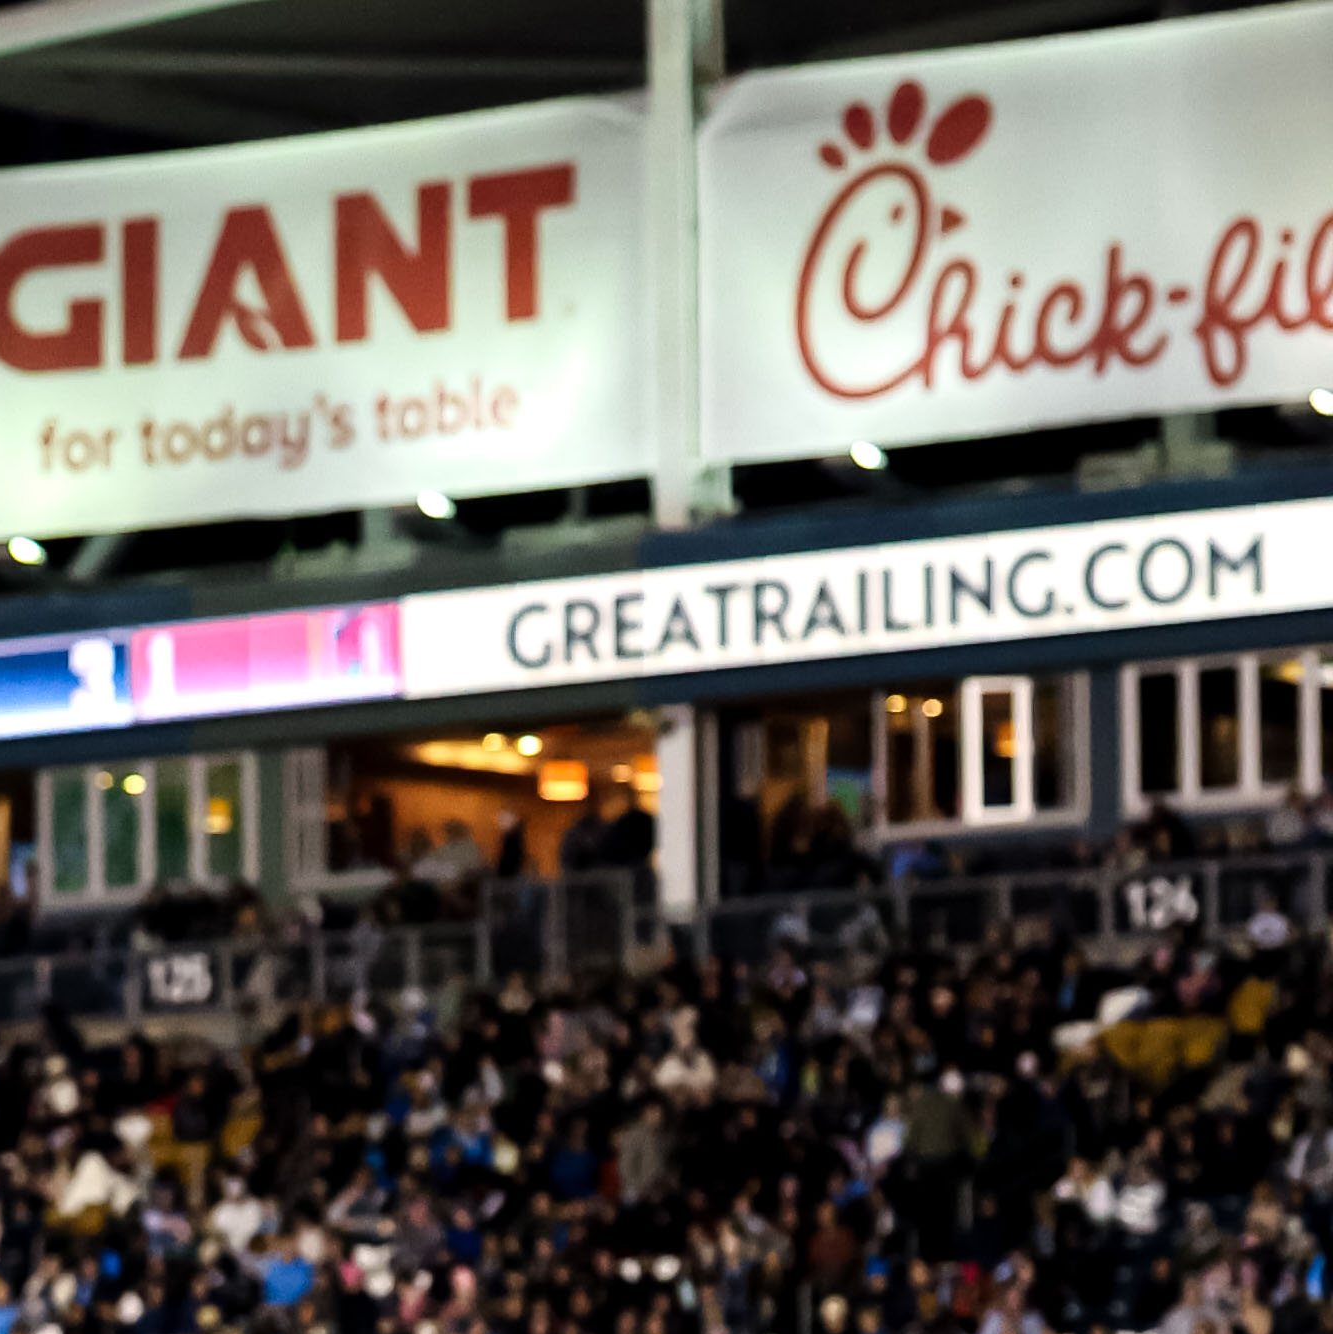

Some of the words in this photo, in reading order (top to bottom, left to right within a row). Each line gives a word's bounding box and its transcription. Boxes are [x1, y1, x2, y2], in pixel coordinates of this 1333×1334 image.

[37, 412, 122, 475] for
[140, 391, 355, 470] today's
[373, 375, 519, 442] table
[505, 534, 1266, 671] GREATRAILING.COM
